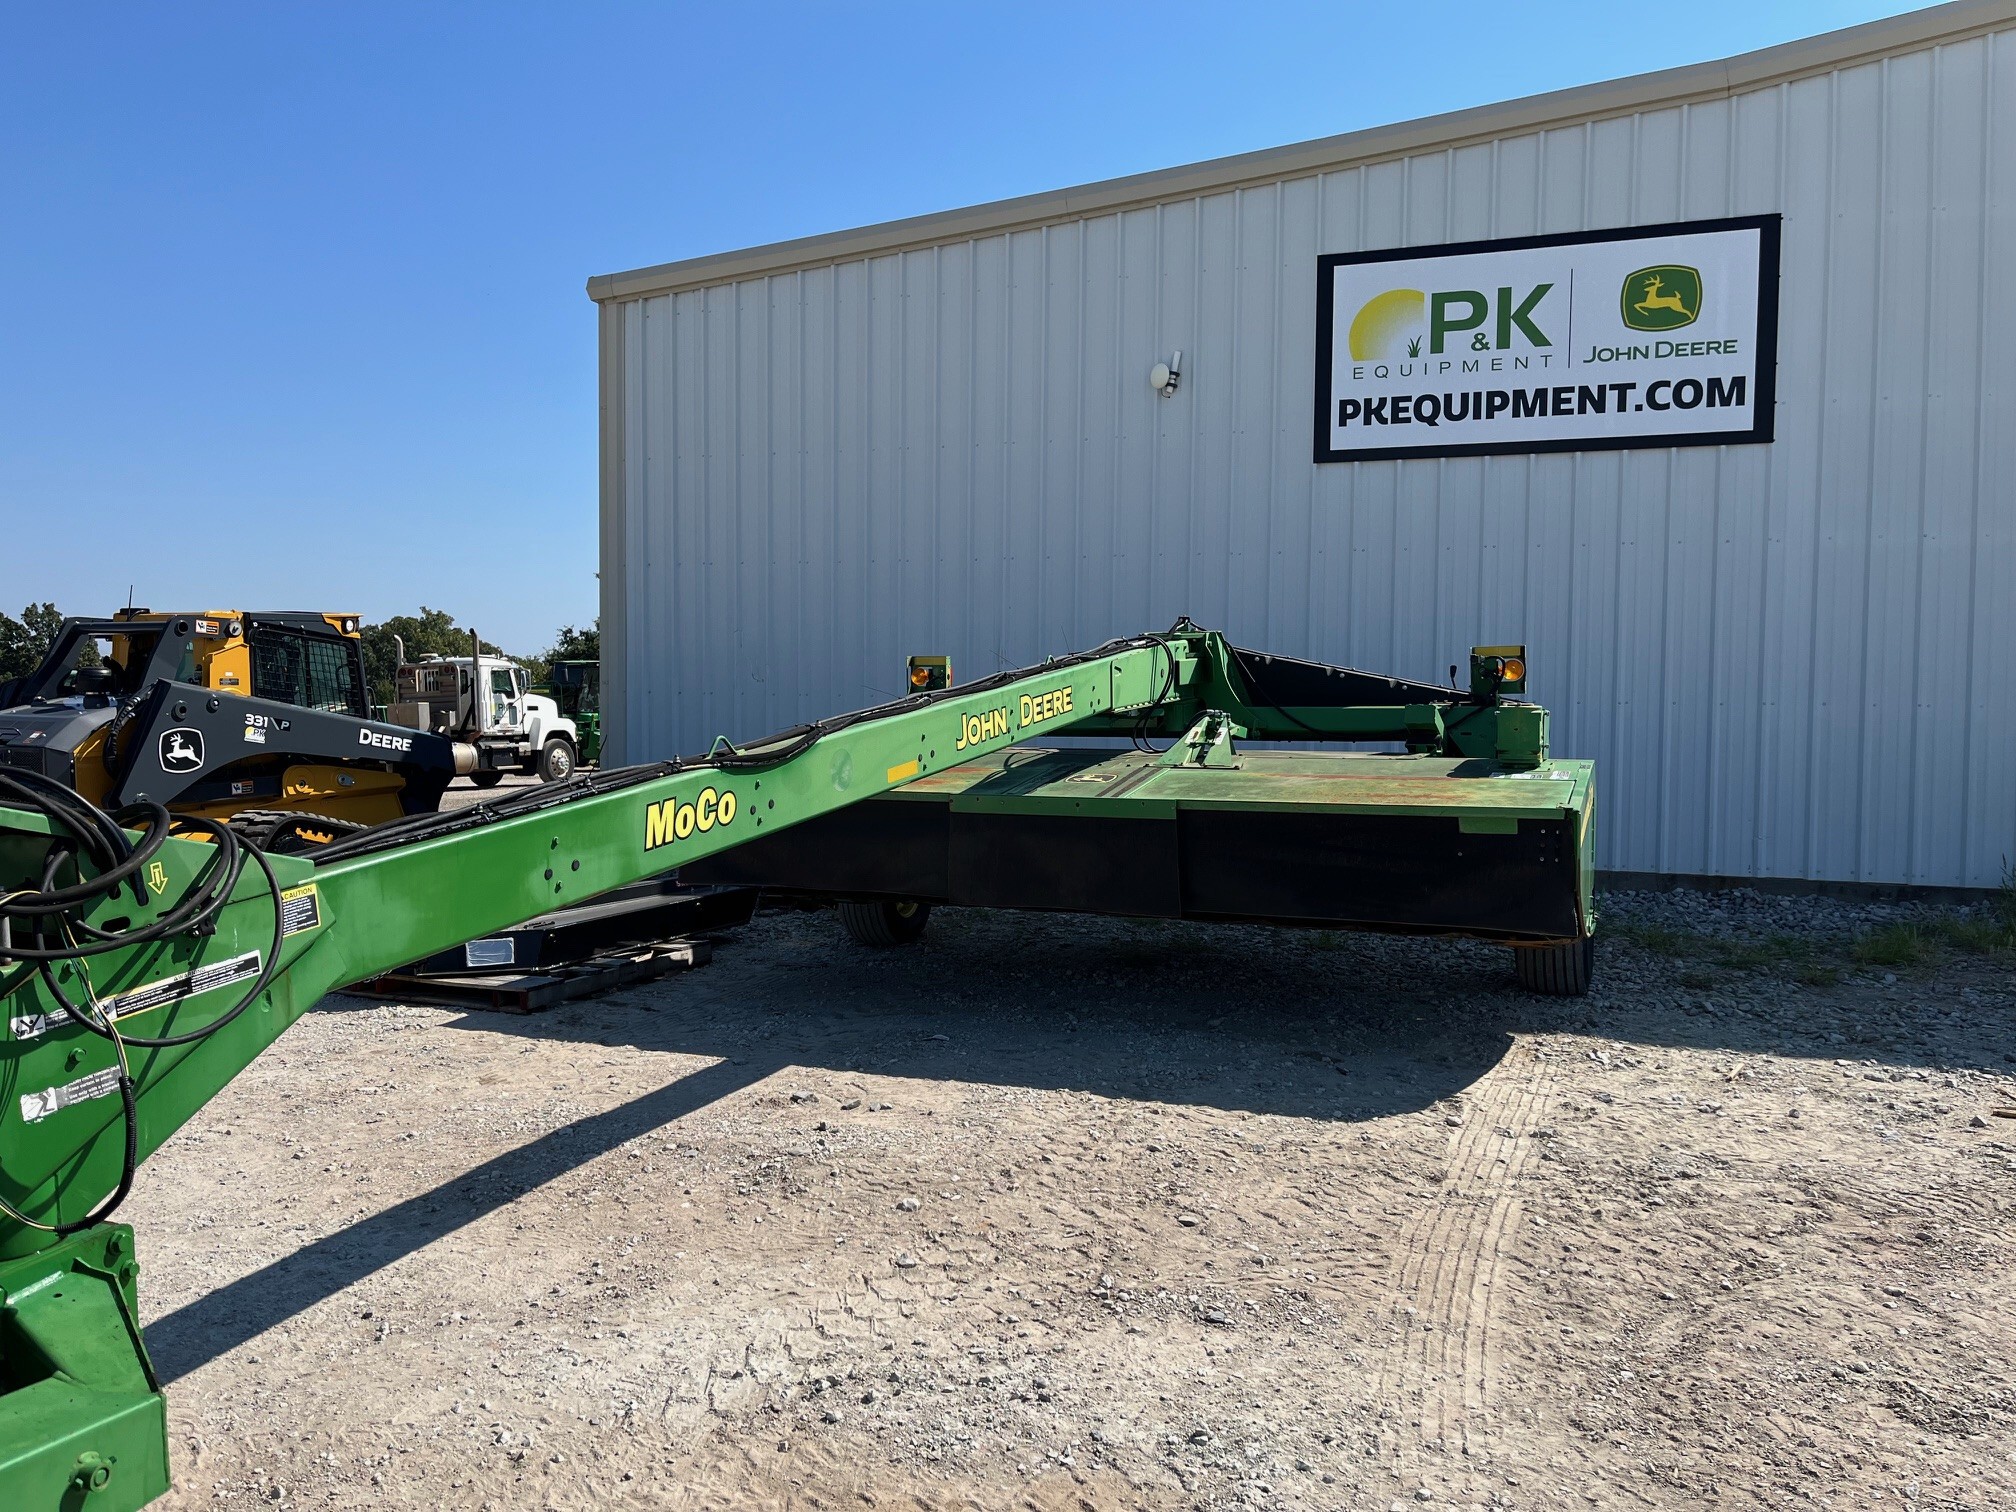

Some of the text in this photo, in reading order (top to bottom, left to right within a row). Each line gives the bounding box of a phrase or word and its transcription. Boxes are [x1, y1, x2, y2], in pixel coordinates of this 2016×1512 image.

[1430, 283, 1554, 354] P&K
[1583, 339, 1738, 363] JOHN DEERE
[1353, 354, 1553, 380] EQUIPMENT
[1338, 376, 1746, 427] PKEQUIPMENT.COM
[245, 713, 268, 728] 331
[956, 685, 1073, 751] JOHN DEERE
[359, 728, 412, 751] DEERE
[644, 786, 737, 852] MoCo
[284, 887, 313, 900] CAUTION
